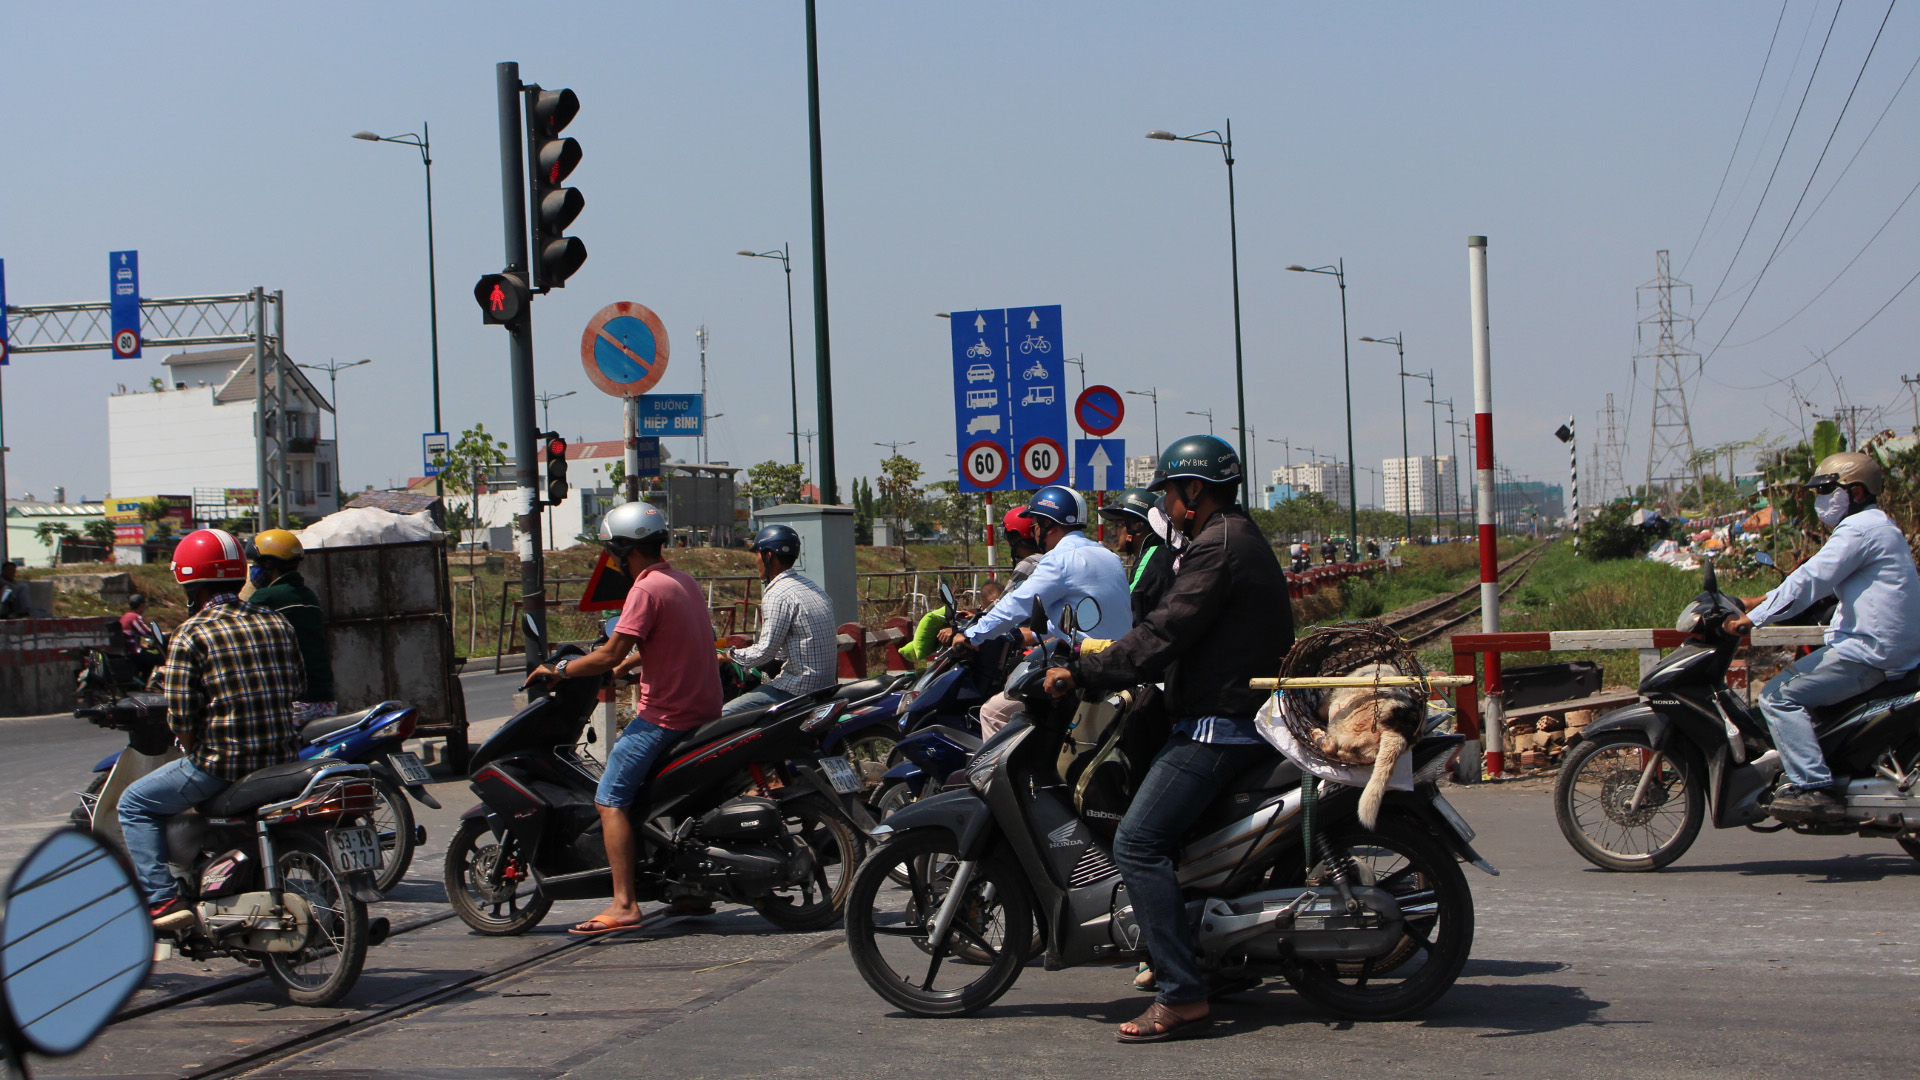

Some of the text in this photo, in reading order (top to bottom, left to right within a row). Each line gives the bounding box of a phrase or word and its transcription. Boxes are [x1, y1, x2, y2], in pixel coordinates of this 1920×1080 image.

[121, 336, 132, 349] 80
[654, 399, 689, 411] ĐƯỜNG
[644, 413, 698, 432] HIỆP BÌNH
[975, 452, 994, 475] 60
[1031, 449, 1051, 472] 60
[1178, 458, 1192, 467] MY
[1192, 458, 1208, 467] BIKE
[1049, 839, 1084, 848] HONDA
[340, 848, 377, 870] 0727
